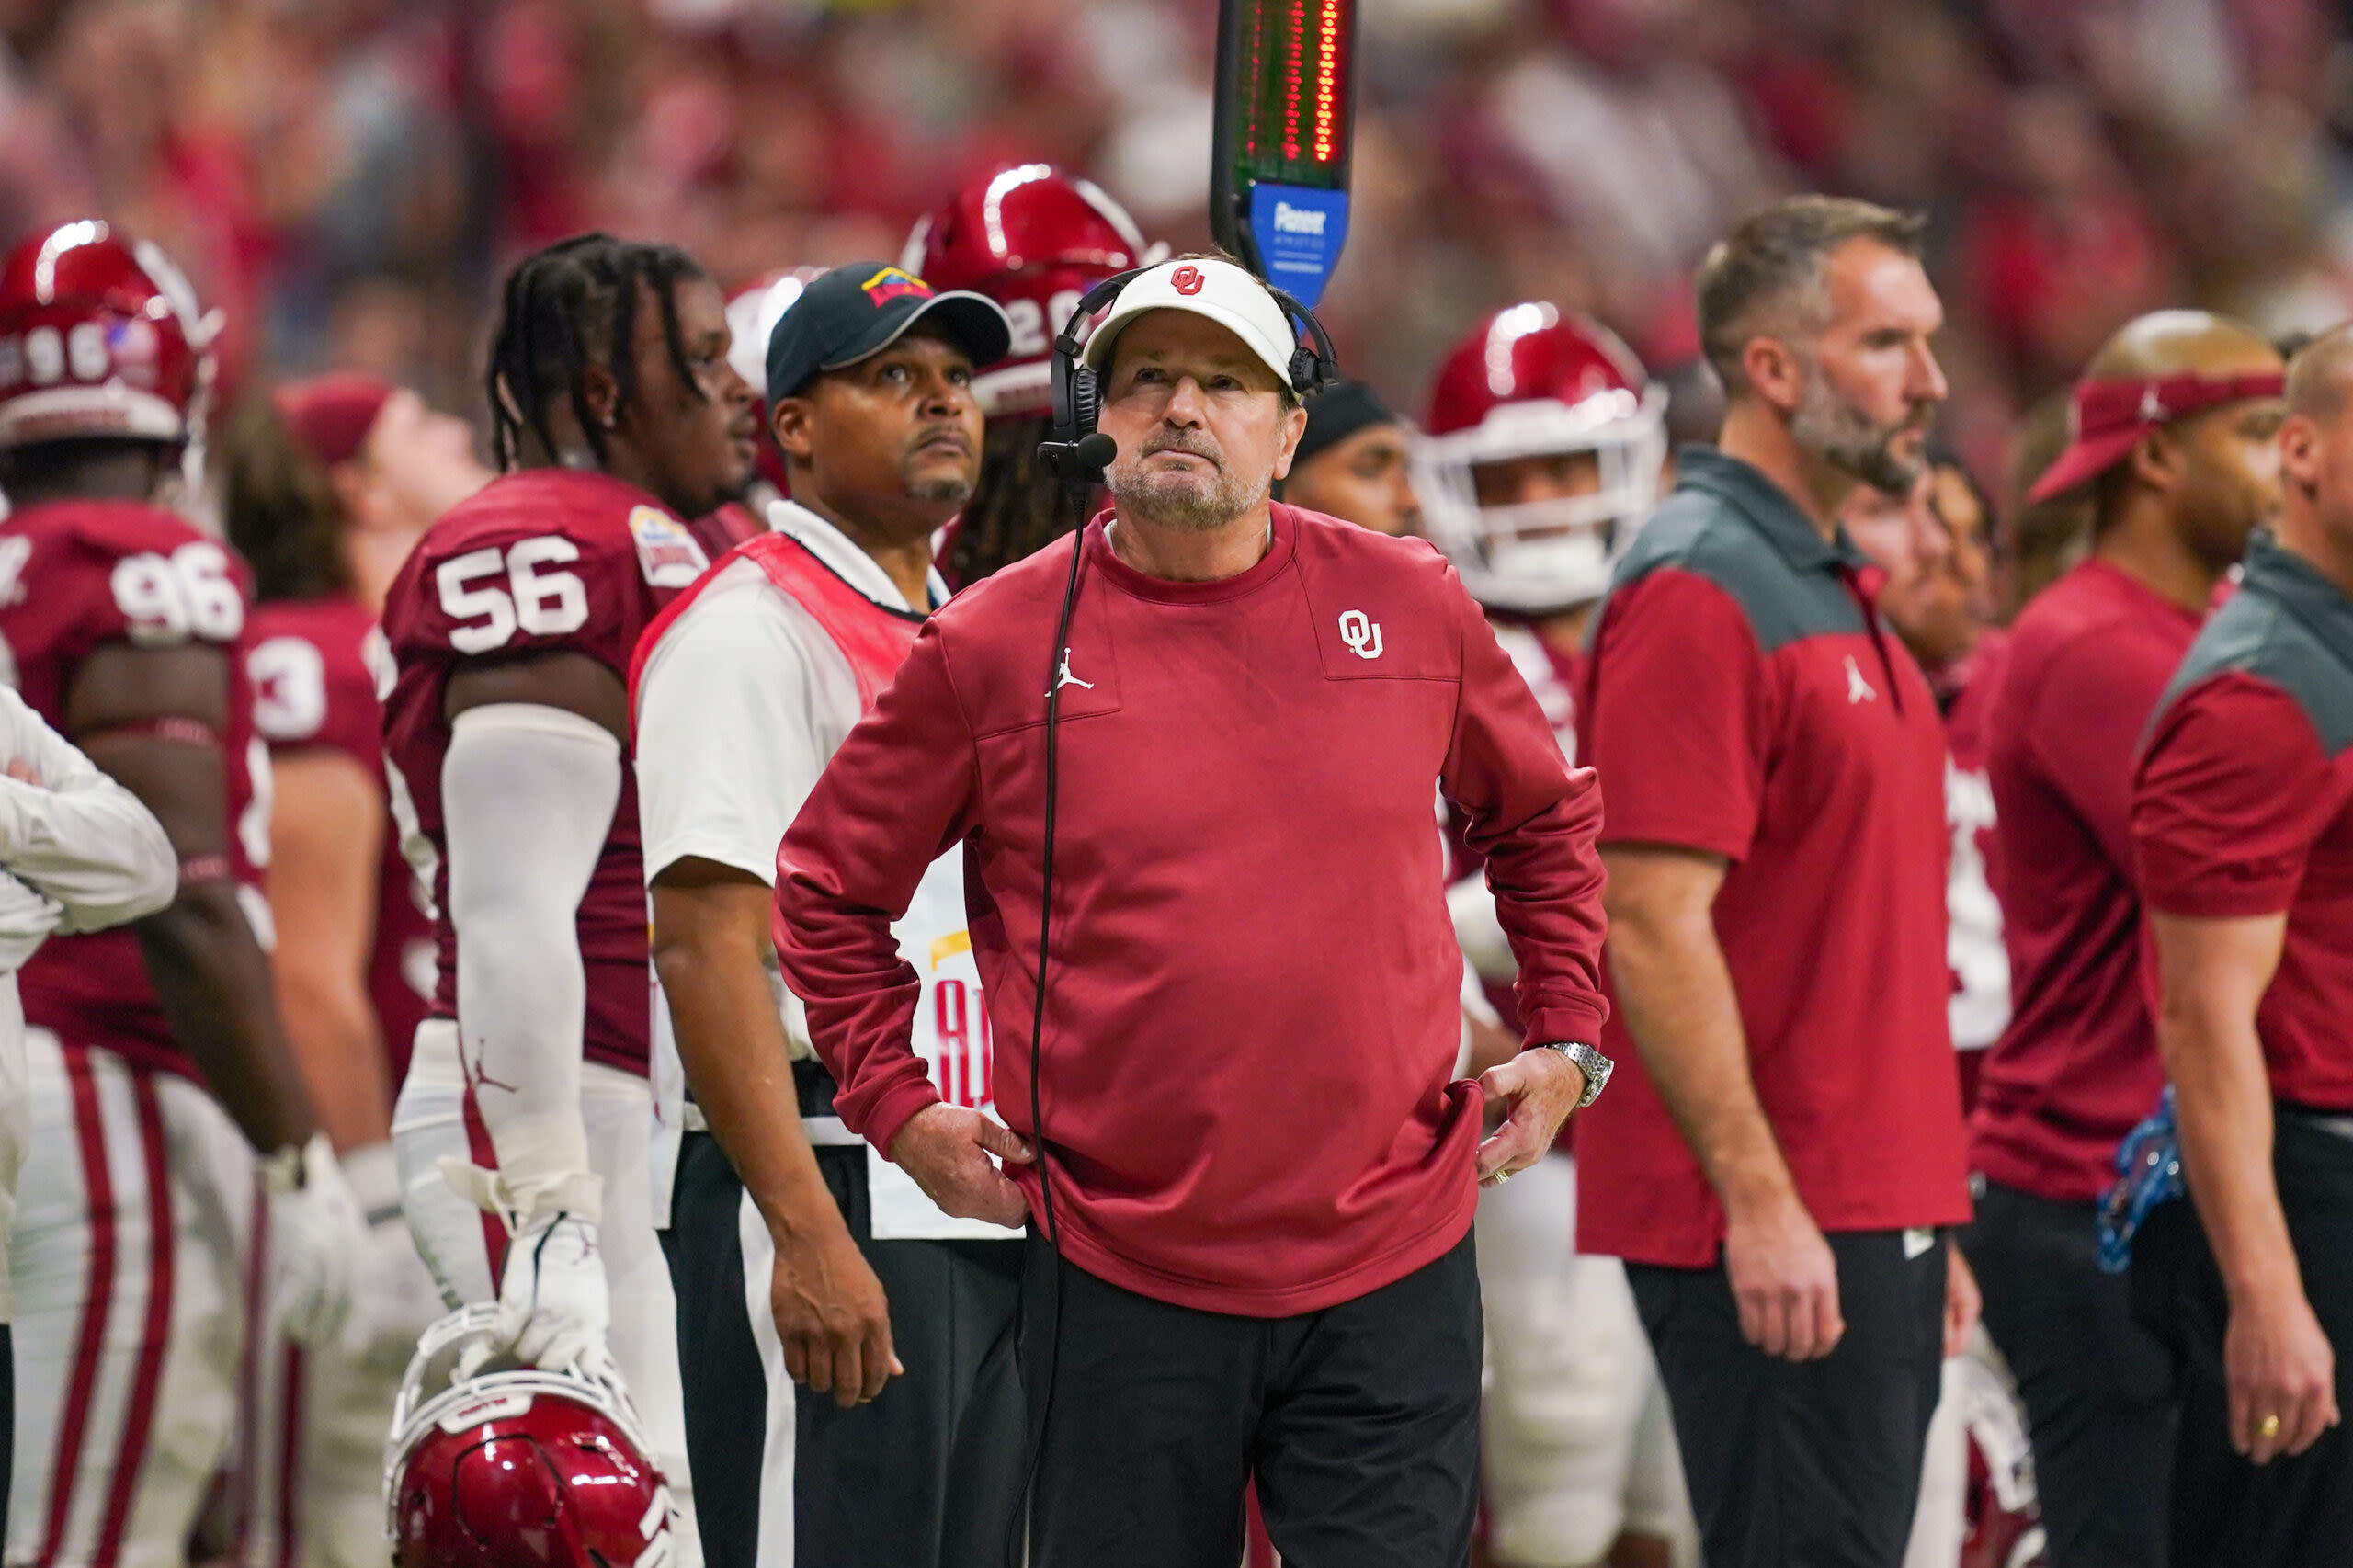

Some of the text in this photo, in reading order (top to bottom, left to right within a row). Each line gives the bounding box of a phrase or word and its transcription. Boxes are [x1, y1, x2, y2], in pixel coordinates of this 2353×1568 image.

[1171, 266, 1205, 295] OU
[110, 540, 245, 644] 96
[436, 535, 589, 655] 56
[1338, 609, 1383, 659] OU
